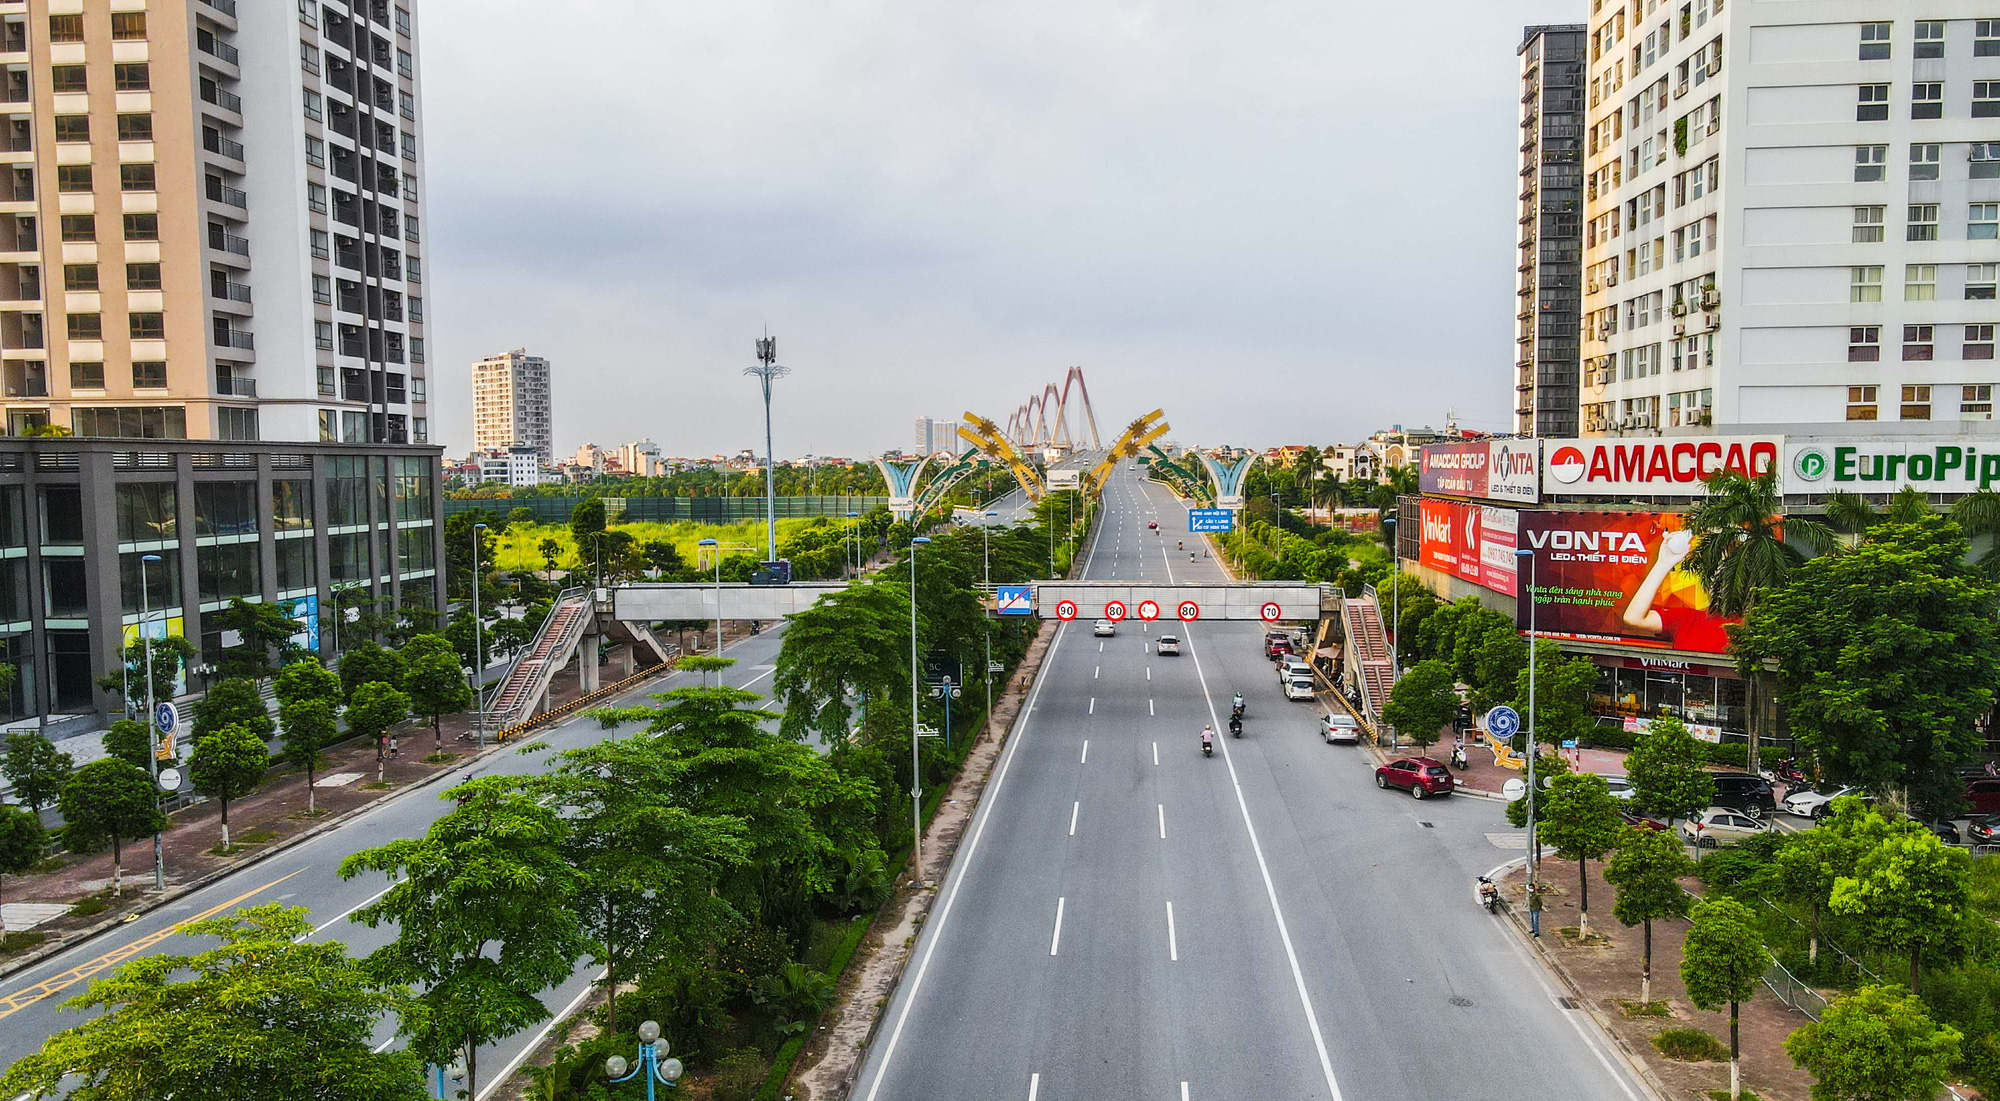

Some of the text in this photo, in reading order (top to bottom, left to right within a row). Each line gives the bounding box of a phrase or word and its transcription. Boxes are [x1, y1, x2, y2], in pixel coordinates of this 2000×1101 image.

[1429, 453, 1485, 470] AMACCAO GROUP
[1492, 445, 1534, 481] VONTA
[1587, 442, 1776, 482] AMACCAO
[1834, 446, 2000, 488] EuroPip
[1491, 484, 1499, 492] LED
[1422, 508, 1451, 544] VinMart
[1526, 529, 1646, 552] VONTA
[1550, 552, 1571, 561] LED
[1576, 551, 1606, 562] THIẾT
[1608, 554, 1619, 565] BỊ
[1621, 554, 1648, 565] ĐIỆN
[1525, 583, 1623, 599] Vonta đèn sáng nhà sang
[1594, 597, 1615, 607] phúc
[1060, 606, 1073, 616] 90
[1109, 606, 1122, 616] 80
[1181, 606, 1195, 616] 80
[1266, 607, 1277, 617] 70
[1640, 658, 1690, 669] VinMart
